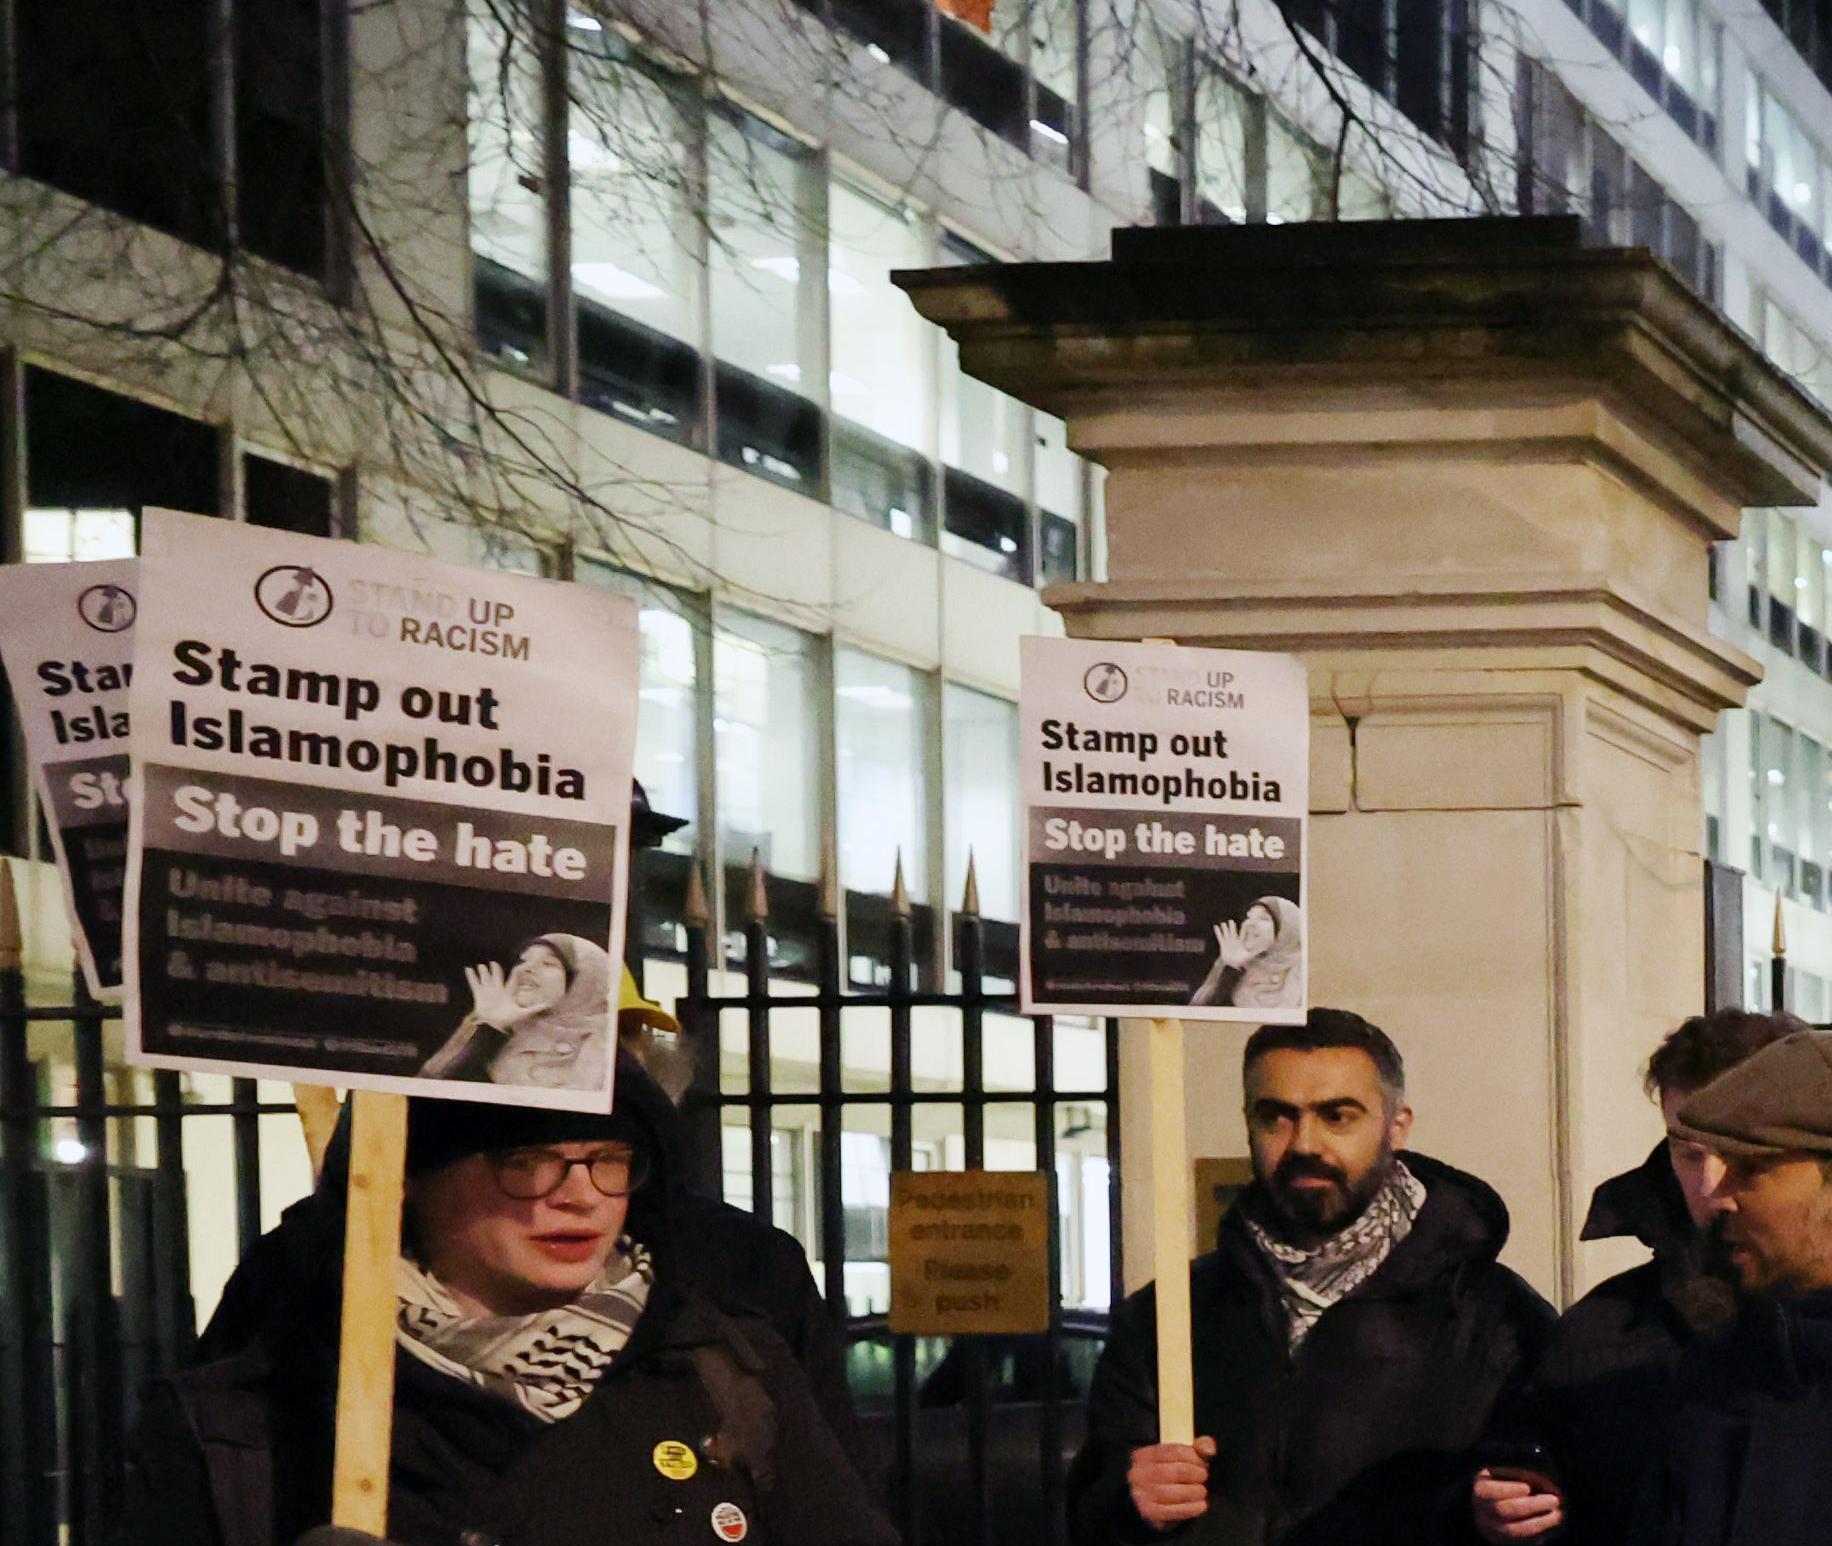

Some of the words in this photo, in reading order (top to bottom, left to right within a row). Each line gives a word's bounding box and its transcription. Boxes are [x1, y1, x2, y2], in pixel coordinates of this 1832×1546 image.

[469, 598, 515, 628] UP
[401, 618, 532, 662] RACISM
[173, 640, 380, 715] Stamp
[401, 682, 500, 731] out
[1167, 688, 1245, 710] RACISM
[1207, 671, 1234, 690] UP
[170, 700, 587, 800] Islamophobia
[1041, 719, 1159, 762] Stamp
[1170, 729, 1229, 758] out
[1043, 761, 1283, 803] Islamophobia
[174, 785, 319, 855] Stop
[337, 809, 437, 861] the
[455, 822, 588, 880] hate
[1044, 817, 1127, 859] Stop
[1135, 821, 1197, 855] the
[1205, 823, 1285, 860] hate
